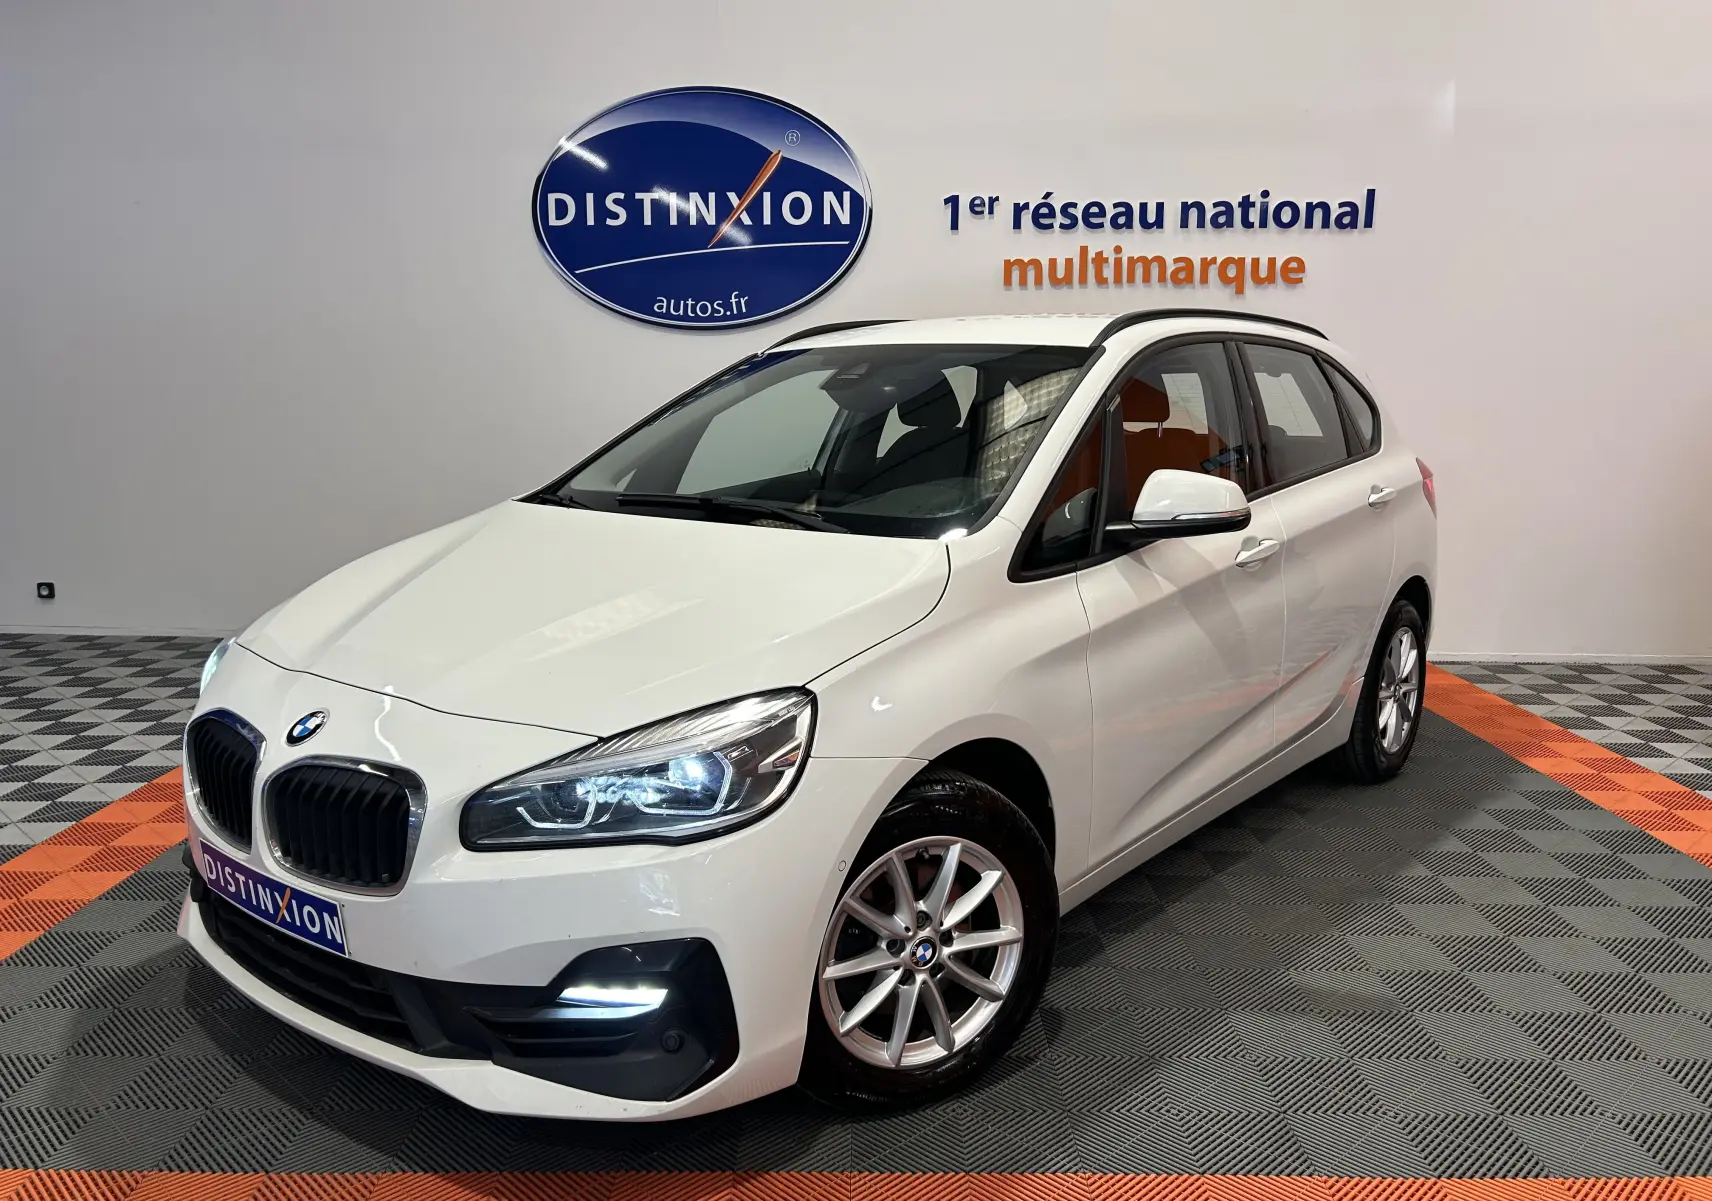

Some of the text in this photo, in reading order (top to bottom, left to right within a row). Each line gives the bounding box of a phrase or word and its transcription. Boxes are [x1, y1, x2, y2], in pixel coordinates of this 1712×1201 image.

[547, 190, 850, 226] DISTINXION
[943, 188, 1377, 231] 1er réseau national
[1002, 245, 1307, 295] multimarque
[653, 291, 749, 317] autos.fr
[203, 852, 343, 944] DISTINXION
